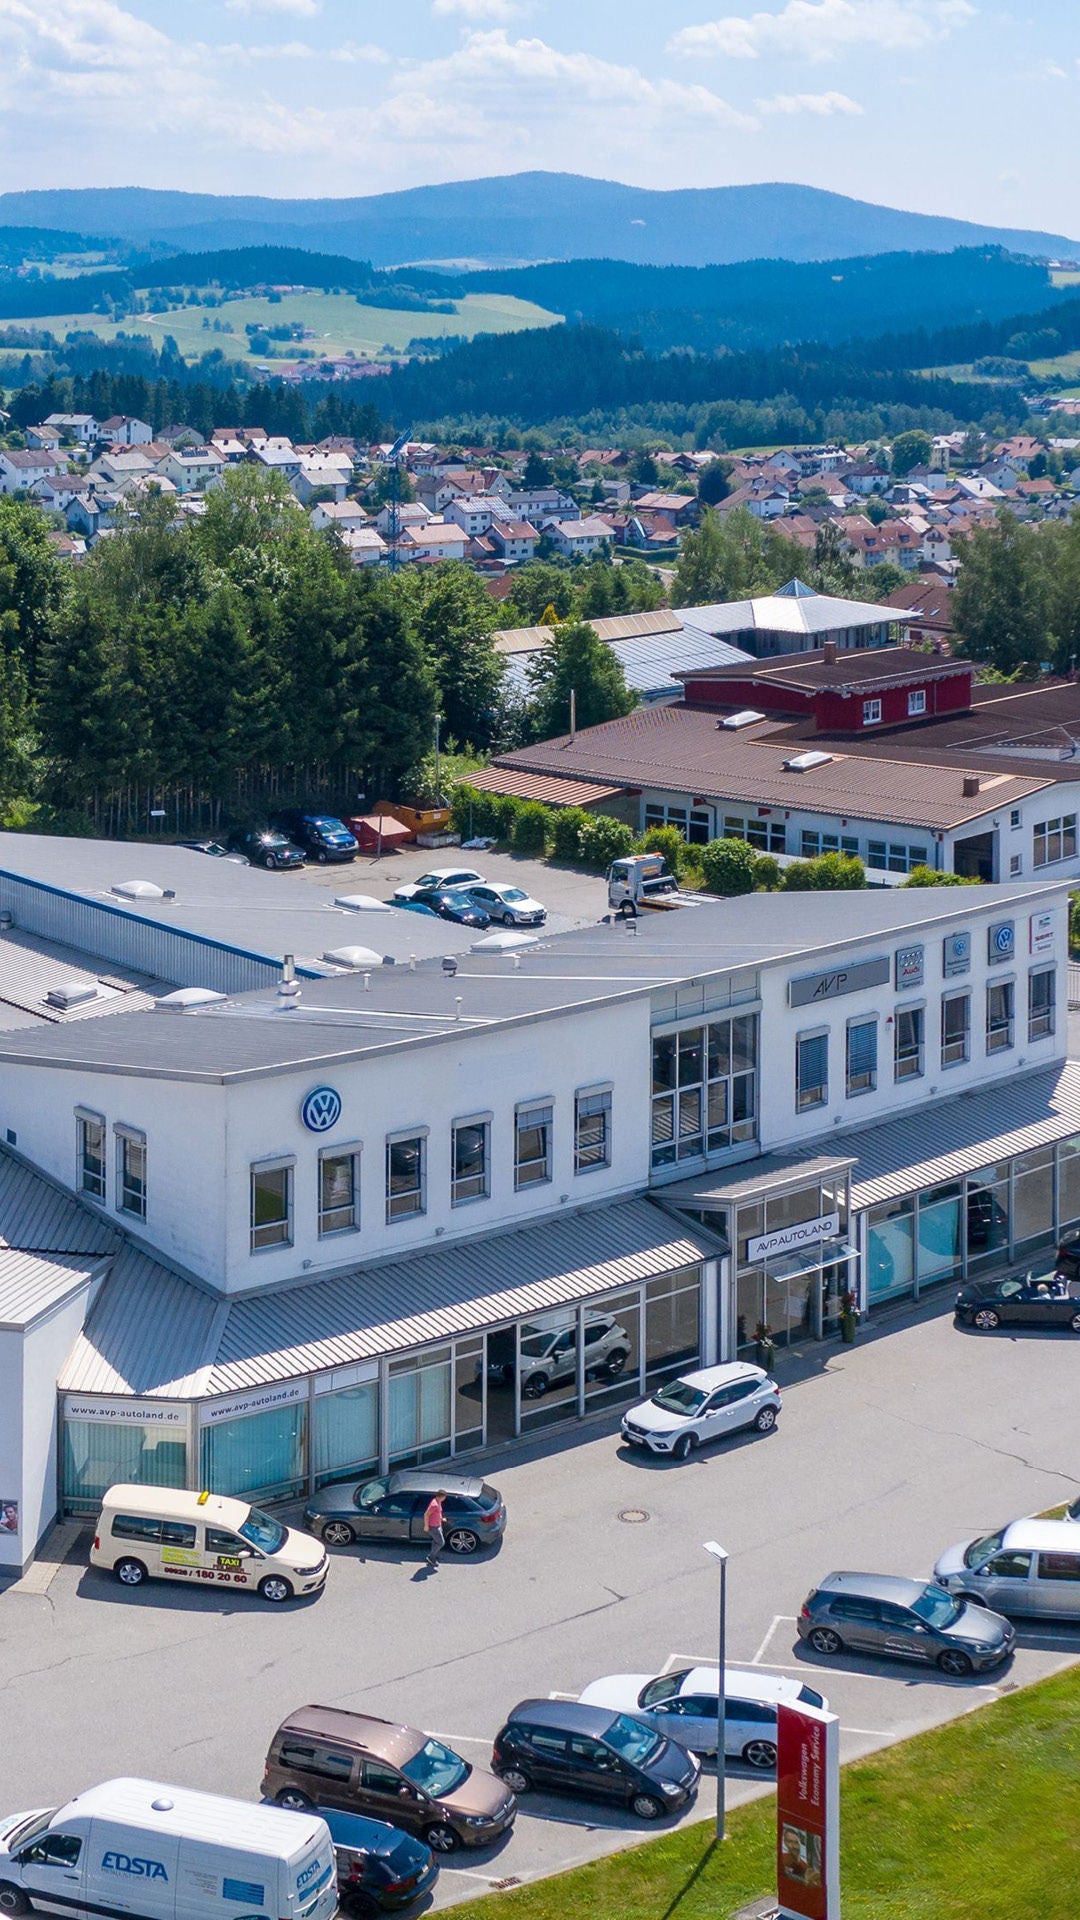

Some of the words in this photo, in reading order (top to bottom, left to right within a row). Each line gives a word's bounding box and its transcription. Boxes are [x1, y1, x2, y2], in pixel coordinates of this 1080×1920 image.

[813, 973, 848, 998] AVP
[71, 1405, 180, 1421] www.avp-autoland.de
[211, 1388, 300, 1418] www.avp-autoland.de
[220, 1557, 240, 1566] TAXI
[217, 1573, 231, 1581] 20
[811, 1726, 821, 1761] Service
[799, 1743, 809, 1801] Volkswagen
[811, 1763, 821, 1807] Economy
[101, 1851, 169, 1882] EDSTA
[296, 1859, 321, 1889] EDSTA
